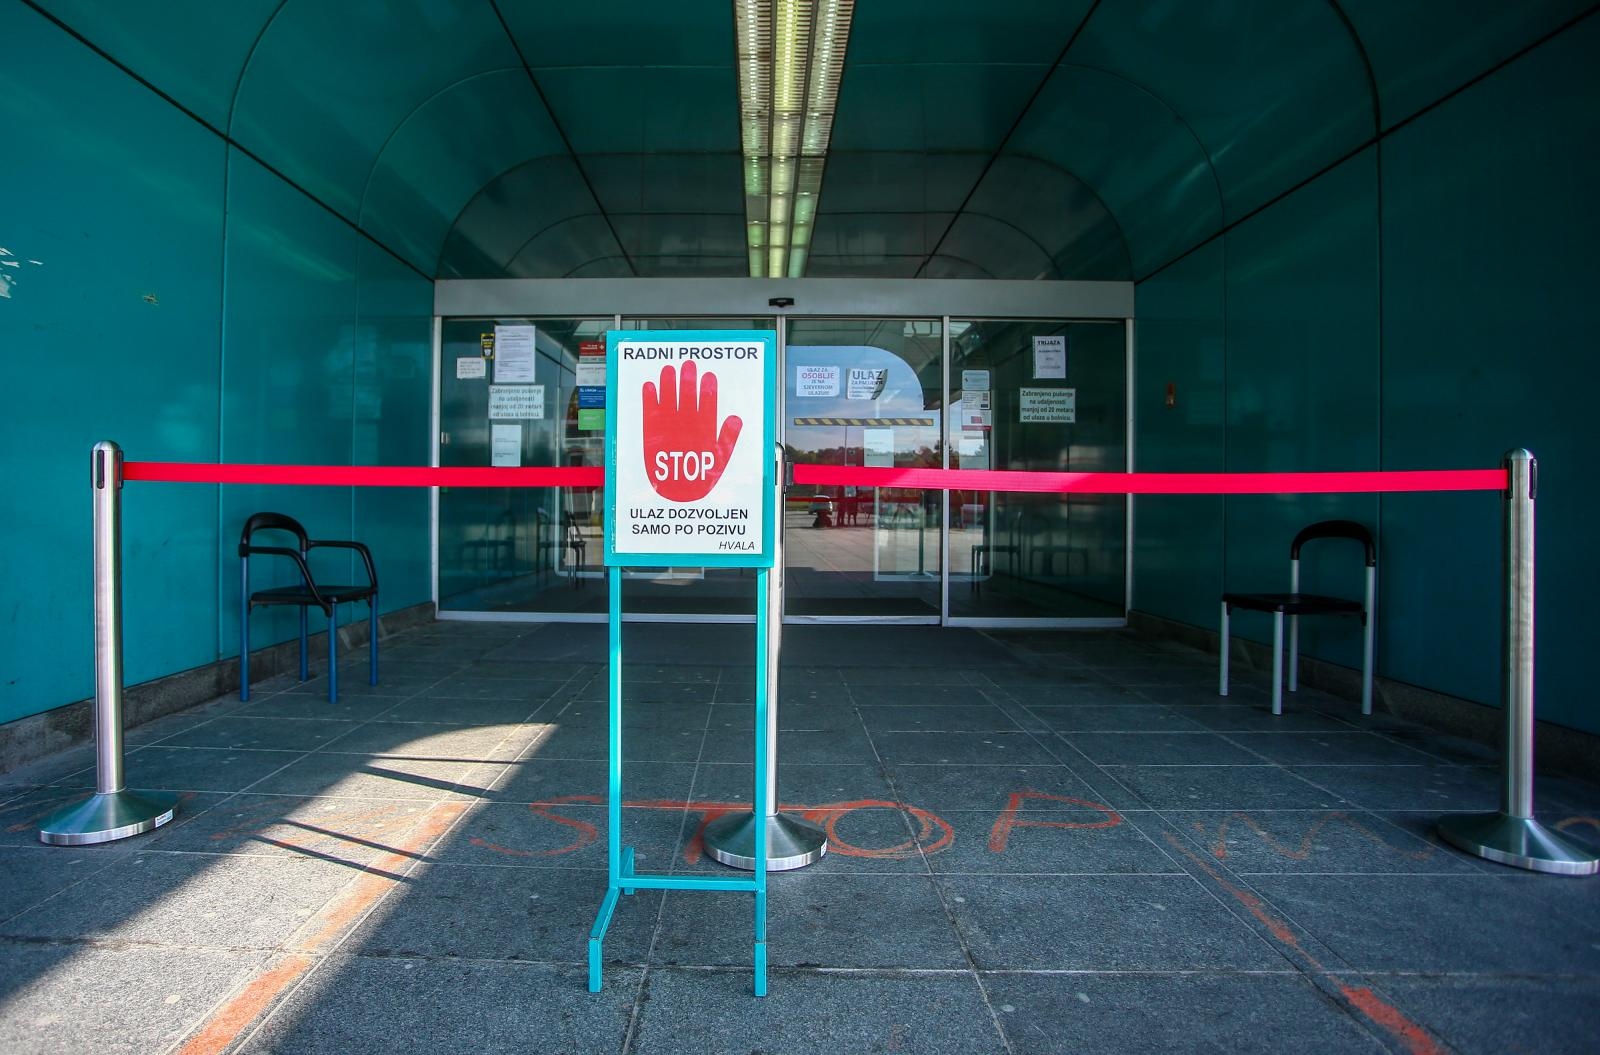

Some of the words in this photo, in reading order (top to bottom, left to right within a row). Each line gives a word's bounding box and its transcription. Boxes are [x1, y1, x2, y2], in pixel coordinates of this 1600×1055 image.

[623, 347, 674, 360] RADNI
[678, 347, 758, 360] PROSTOR
[852, 370, 883, 380] ULAZ
[1022, 390, 1052, 398] Zabranjeno
[1021, 406, 1040, 414] manjoj
[654, 451, 716, 482] STOP
[629, 508, 665, 520] ULAZ
[668, 508, 749, 520] DOZVOLJEN
[631, 524, 671, 536] SAMO
[674, 524, 694, 536] PO
[697, 524, 747, 536] POZIVU
[718, 541, 756, 551] HVALA
